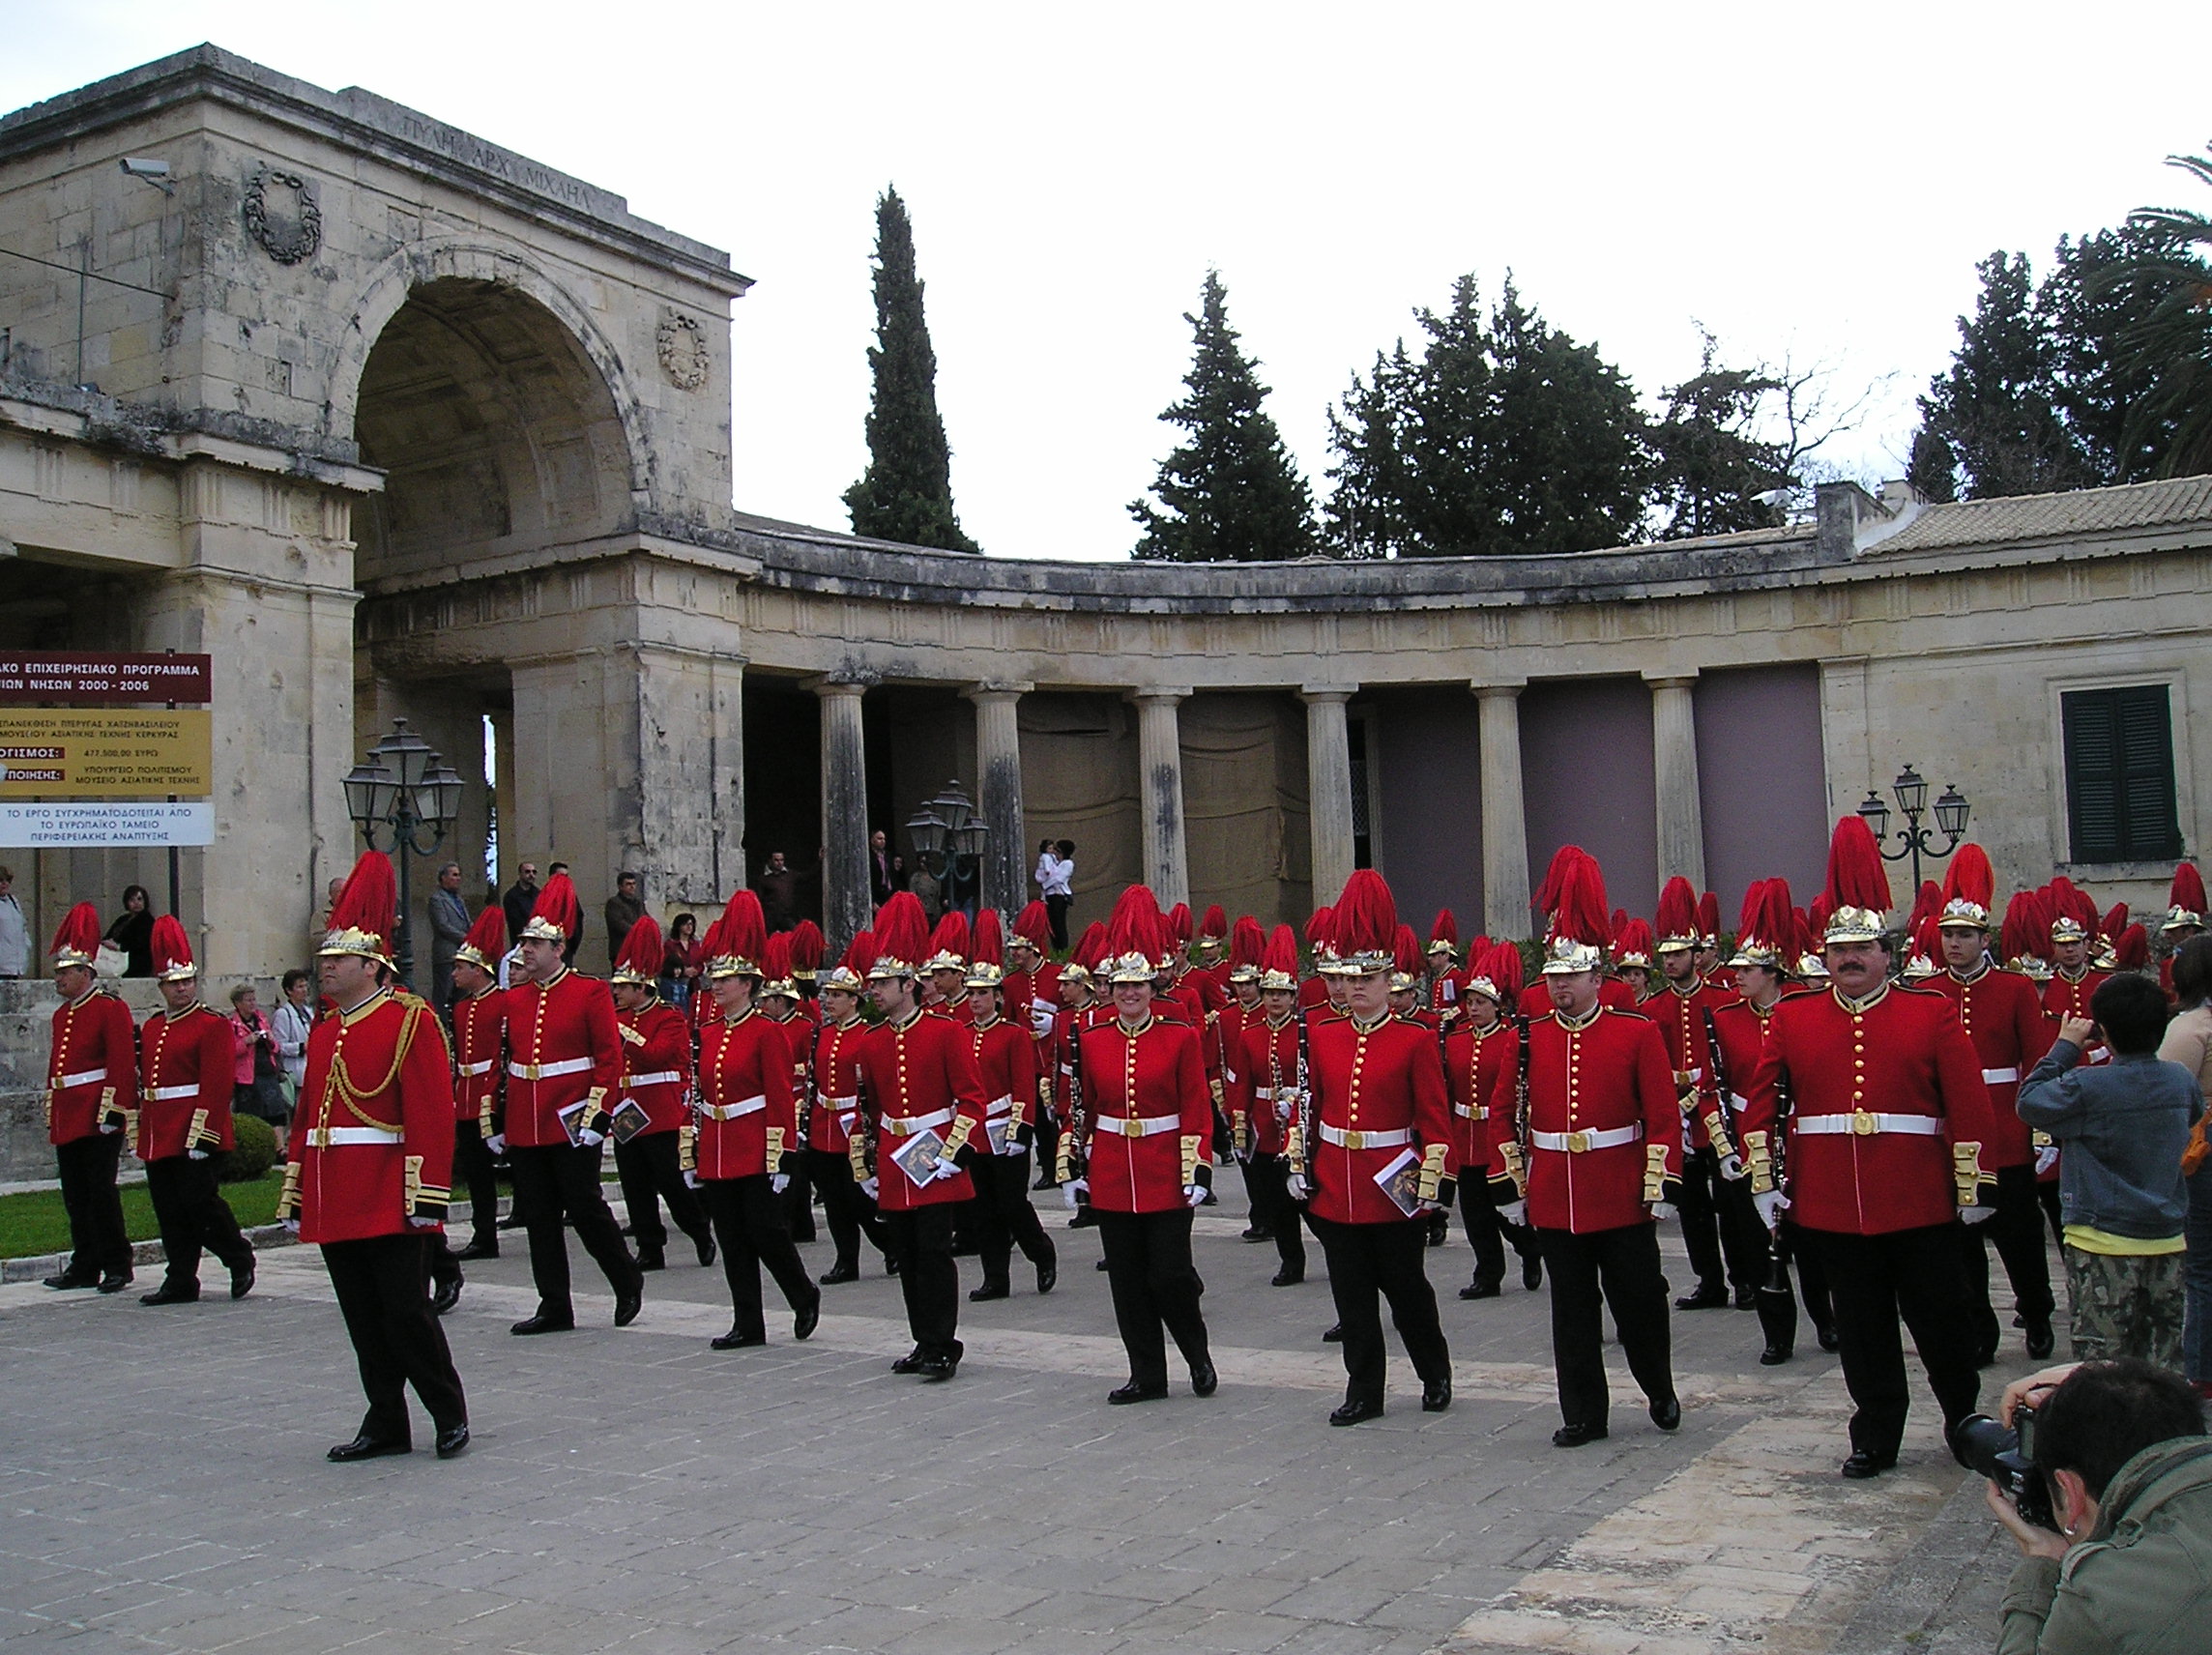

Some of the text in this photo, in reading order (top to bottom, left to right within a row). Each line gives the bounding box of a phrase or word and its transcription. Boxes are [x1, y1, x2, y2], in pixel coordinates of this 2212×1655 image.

[526, 166, 592, 209] ΜΙΧΑΗΛ
[25, 663, 117, 675] ΕΠΙΧΕΙΡΗΣΙΑΚΟ
[123, 664, 200, 676] ΠΡΟΓΡΑΜΜΑ
[30, 680, 73, 690] ΝΗΣΩΝ
[78, 680, 109, 690] 2000
[120, 681, 150, 691] 2006
[84, 766, 133, 774] ΥΠΟΥΡΓΕΙΟ
[7, 808, 191, 818] ΤΟ ΕΡΓΟ ΣΥΓΧΡΗΜΑΤΟΔΟΤΕΙΤΑΙ ΑΠΟ
[41, 819, 160, 829] ΤΟ ΕΥΡΩΠΑΪΚΟ ΤΑΜΕΙΟ
[31, 832, 169, 841] ΠΕΡΙΦΕΡΕΙΑΚΗΣ ΑΝΑΠΤΥΞΗΣ
